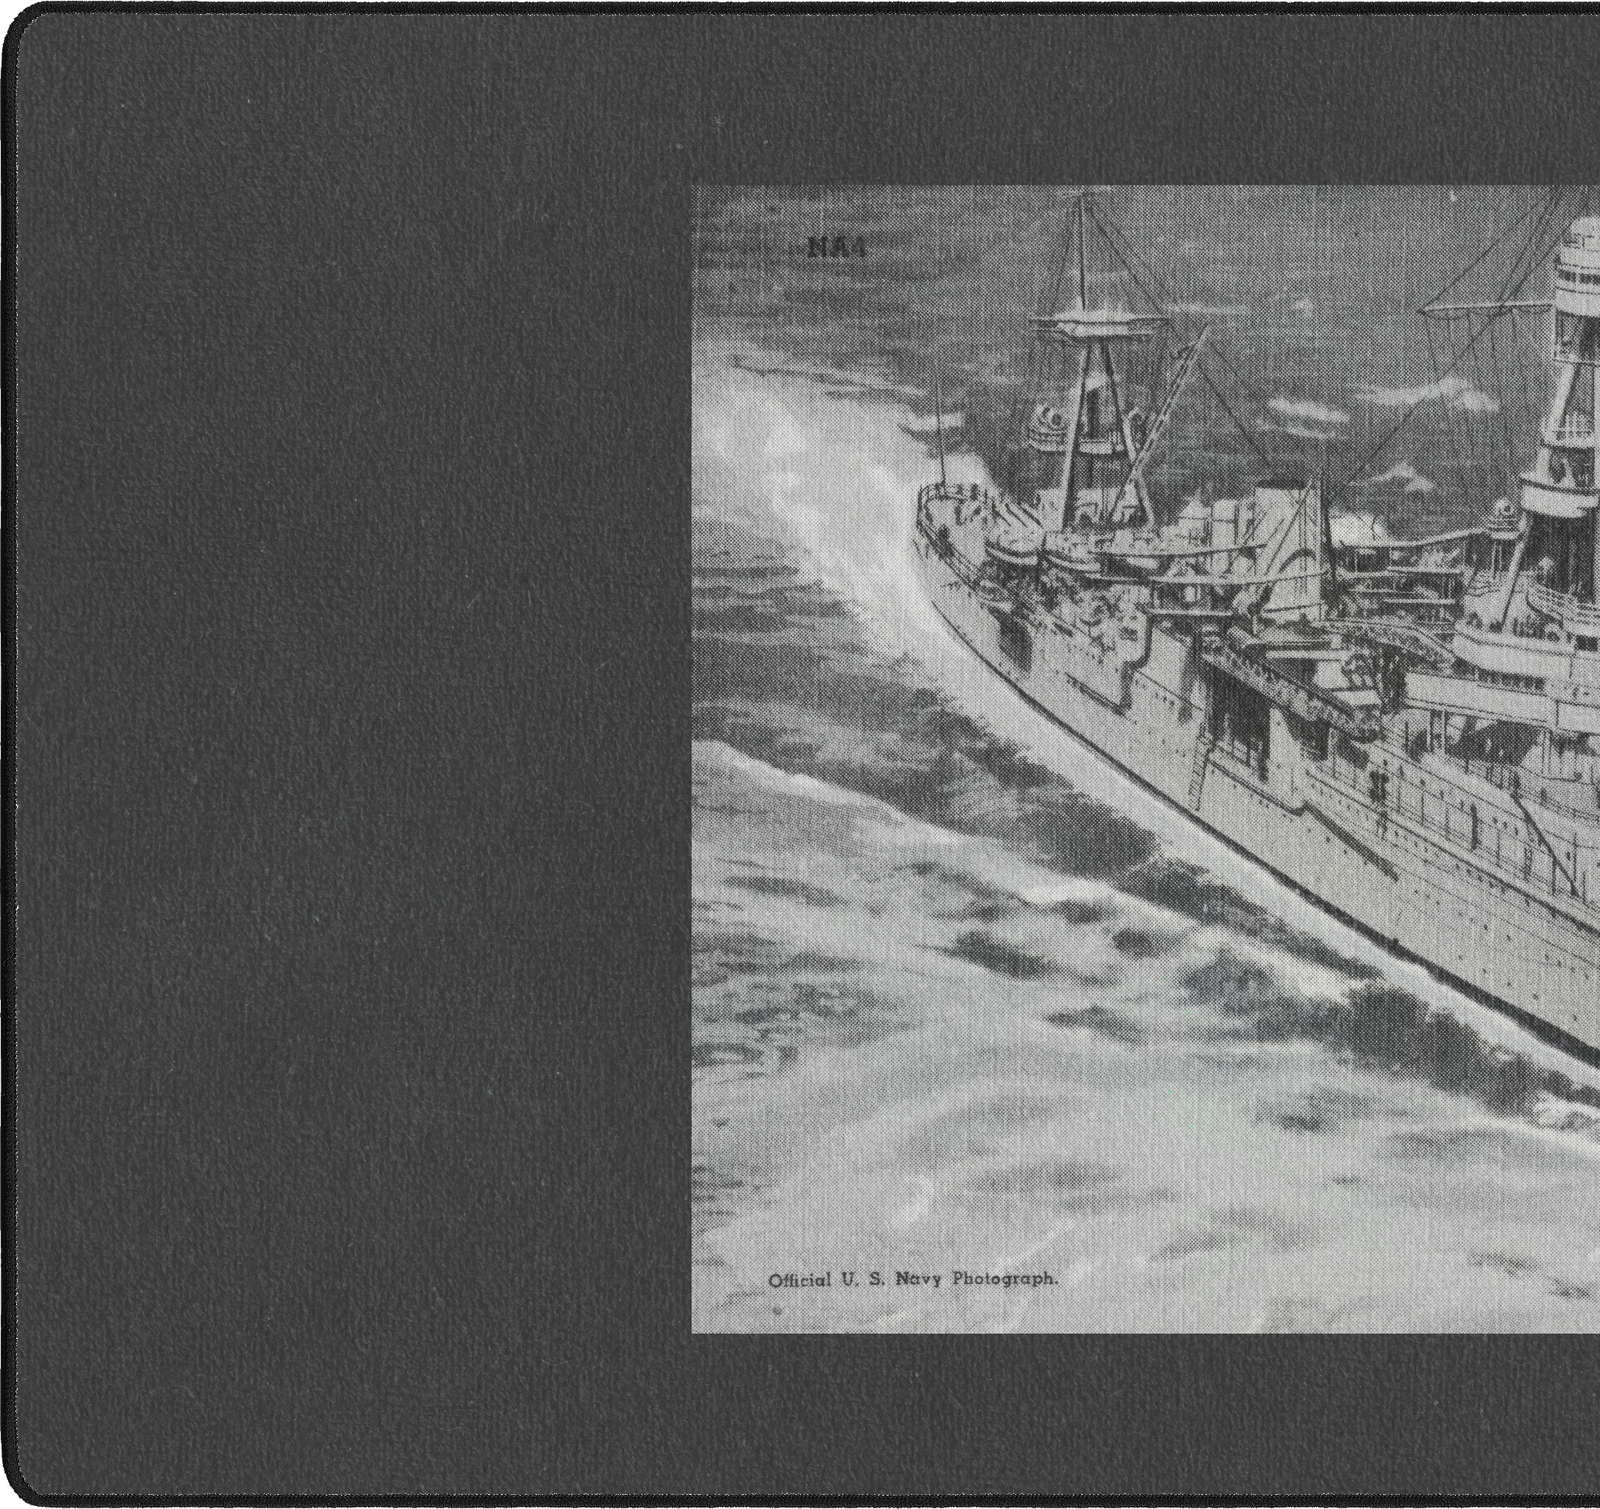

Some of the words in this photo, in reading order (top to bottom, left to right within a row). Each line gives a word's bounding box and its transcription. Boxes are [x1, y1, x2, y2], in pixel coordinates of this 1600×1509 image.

[807, 235, 867, 258] NA4
[768, 1271, 831, 1288] Official
[841, 1271, 859, 1287] U.
[869, 1271, 886, 1287] S.
[895, 1270, 942, 1288] Navy
[952, 1270, 1059, 1288] Photograph.
